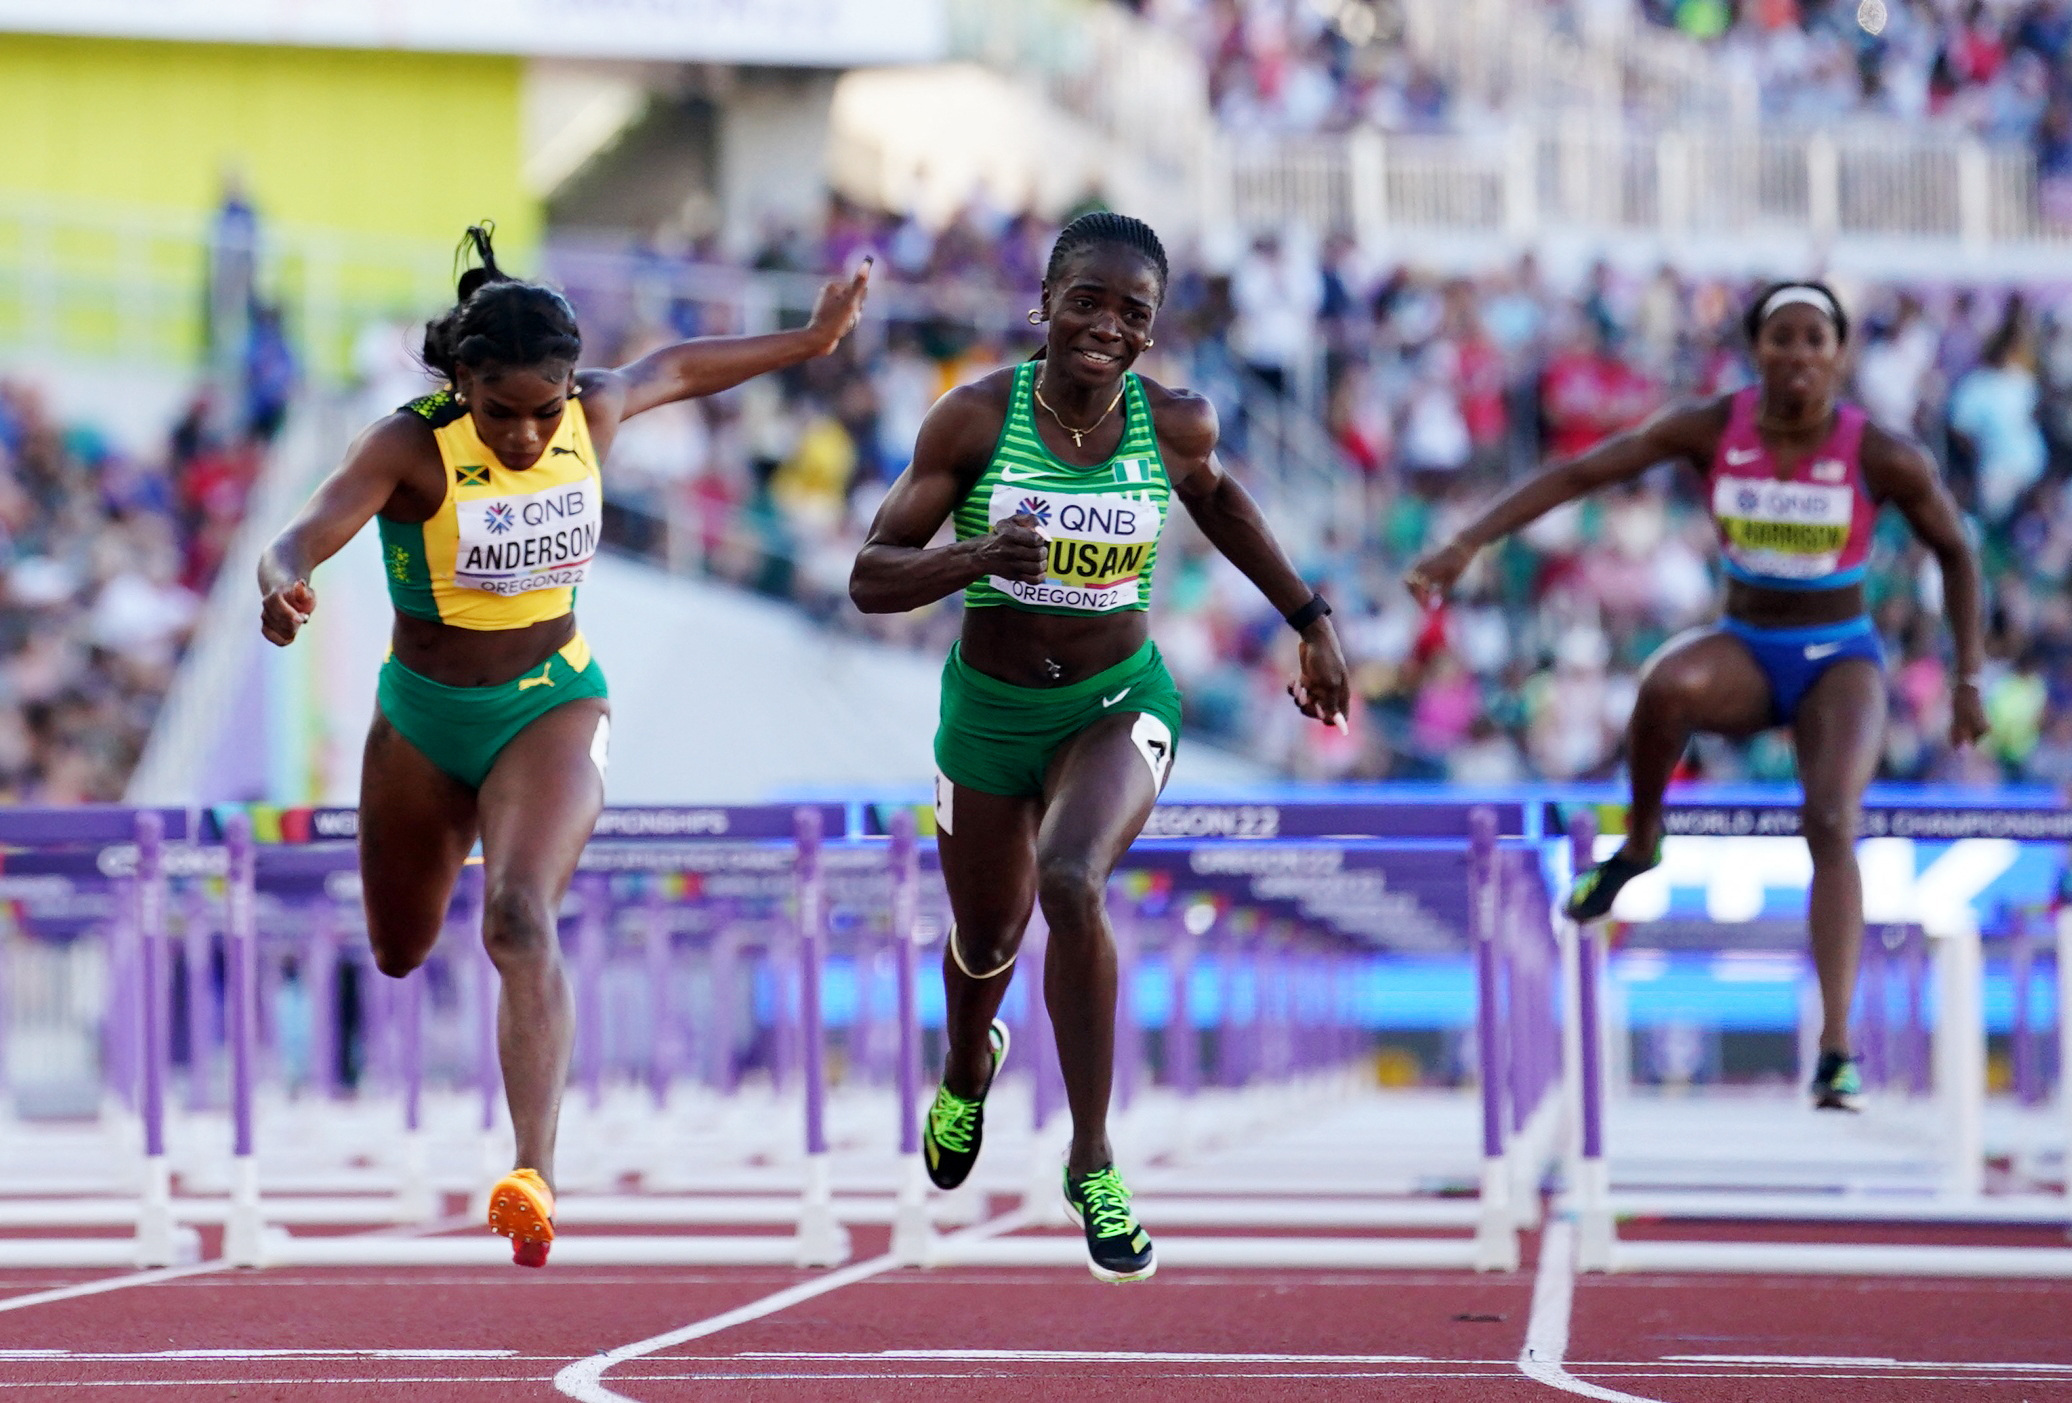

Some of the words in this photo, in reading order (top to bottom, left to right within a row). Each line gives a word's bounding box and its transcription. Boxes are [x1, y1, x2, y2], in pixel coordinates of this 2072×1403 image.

[523, 492, 584, 526] QNB
[1060, 504, 1136, 535] QNB
[465, 521, 596, 570] ANDERSON
[1047, 540, 1144, 578] USAN
[481, 570, 584, 594] OREGON22
[1012, 581, 1119, 608] OREGON22
[1661, 808, 1756, 834] WORLD
